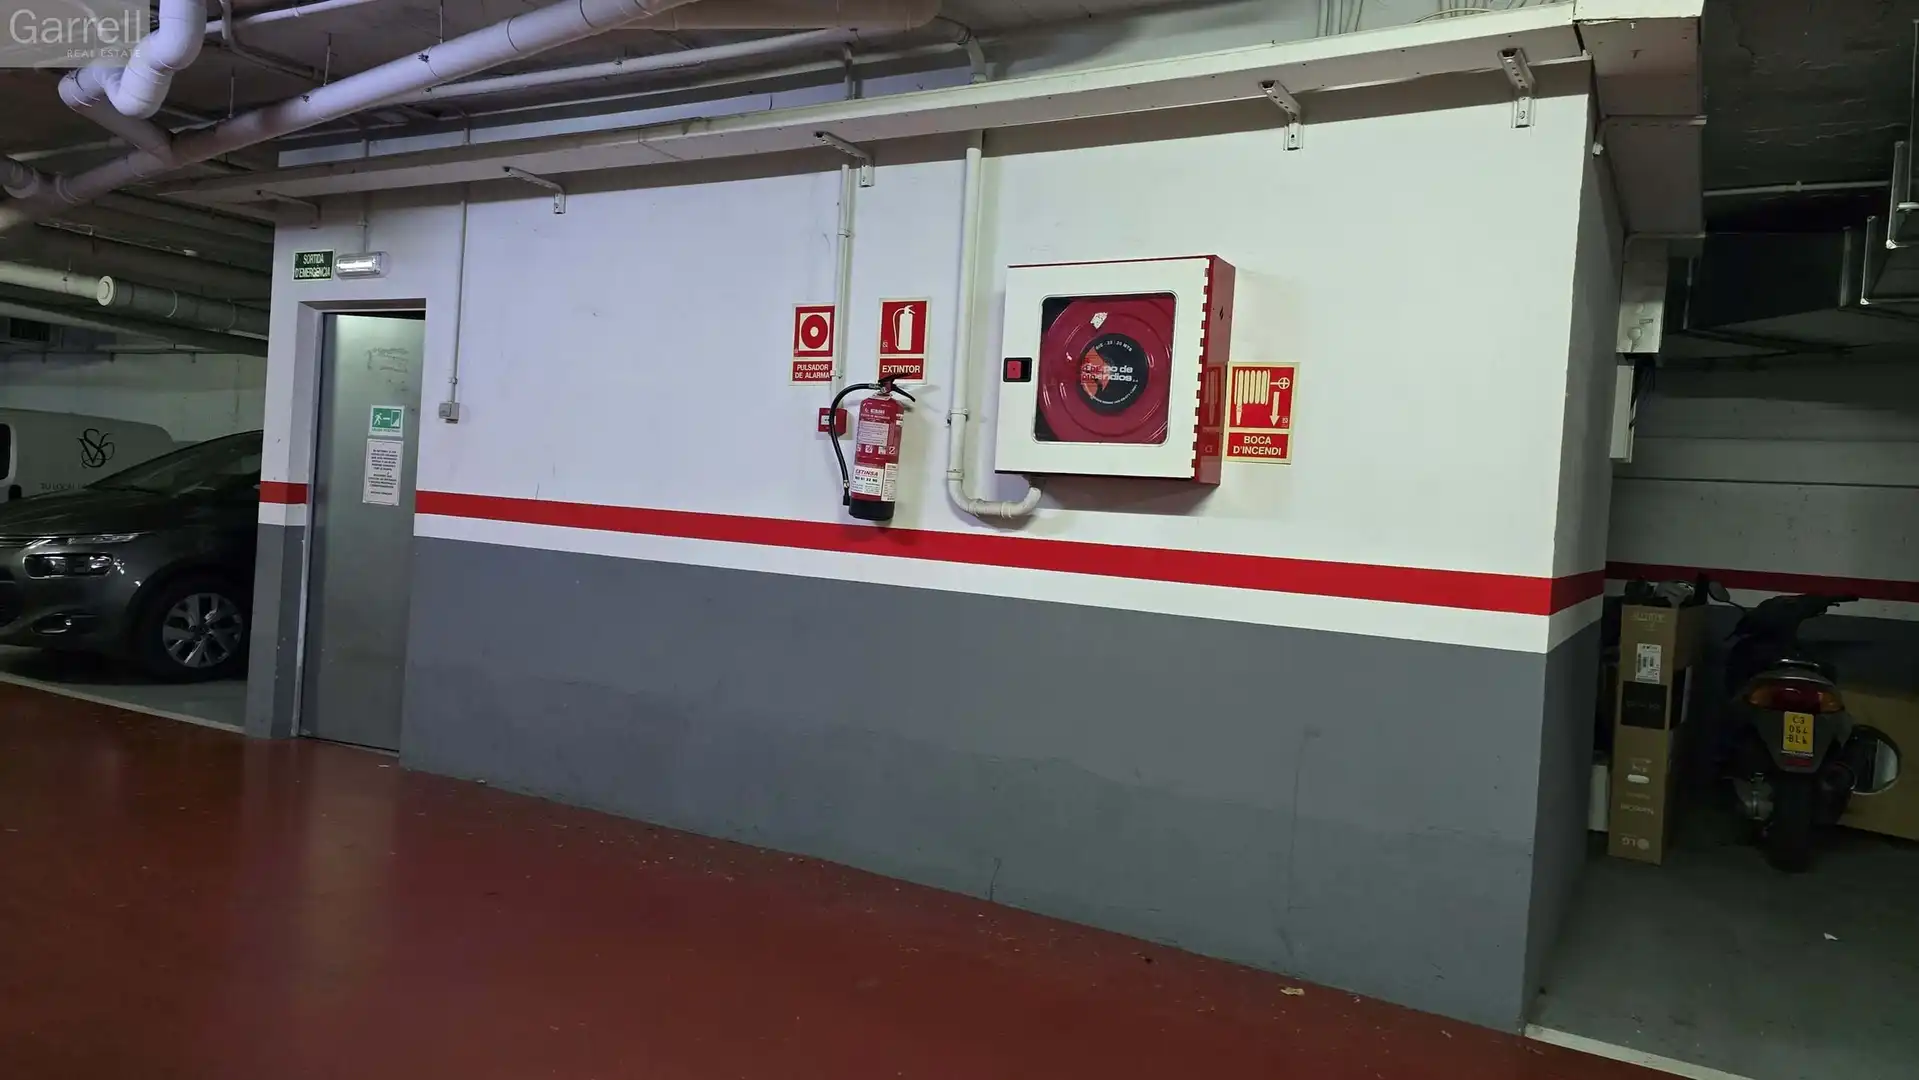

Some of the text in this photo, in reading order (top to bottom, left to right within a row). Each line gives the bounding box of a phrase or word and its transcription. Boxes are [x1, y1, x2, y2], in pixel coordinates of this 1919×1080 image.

[303, 253, 324, 264] SORTIDA
[881, 364, 921, 374] EXTINTOR
[1119, 364, 1134, 373] de
[804, 371, 831, 379] ALARMA
[1243, 435, 1272, 445] BOCA
[1232, 446, 1282, 456] D'INCENDI
[1621, 837, 1636, 847] LG
